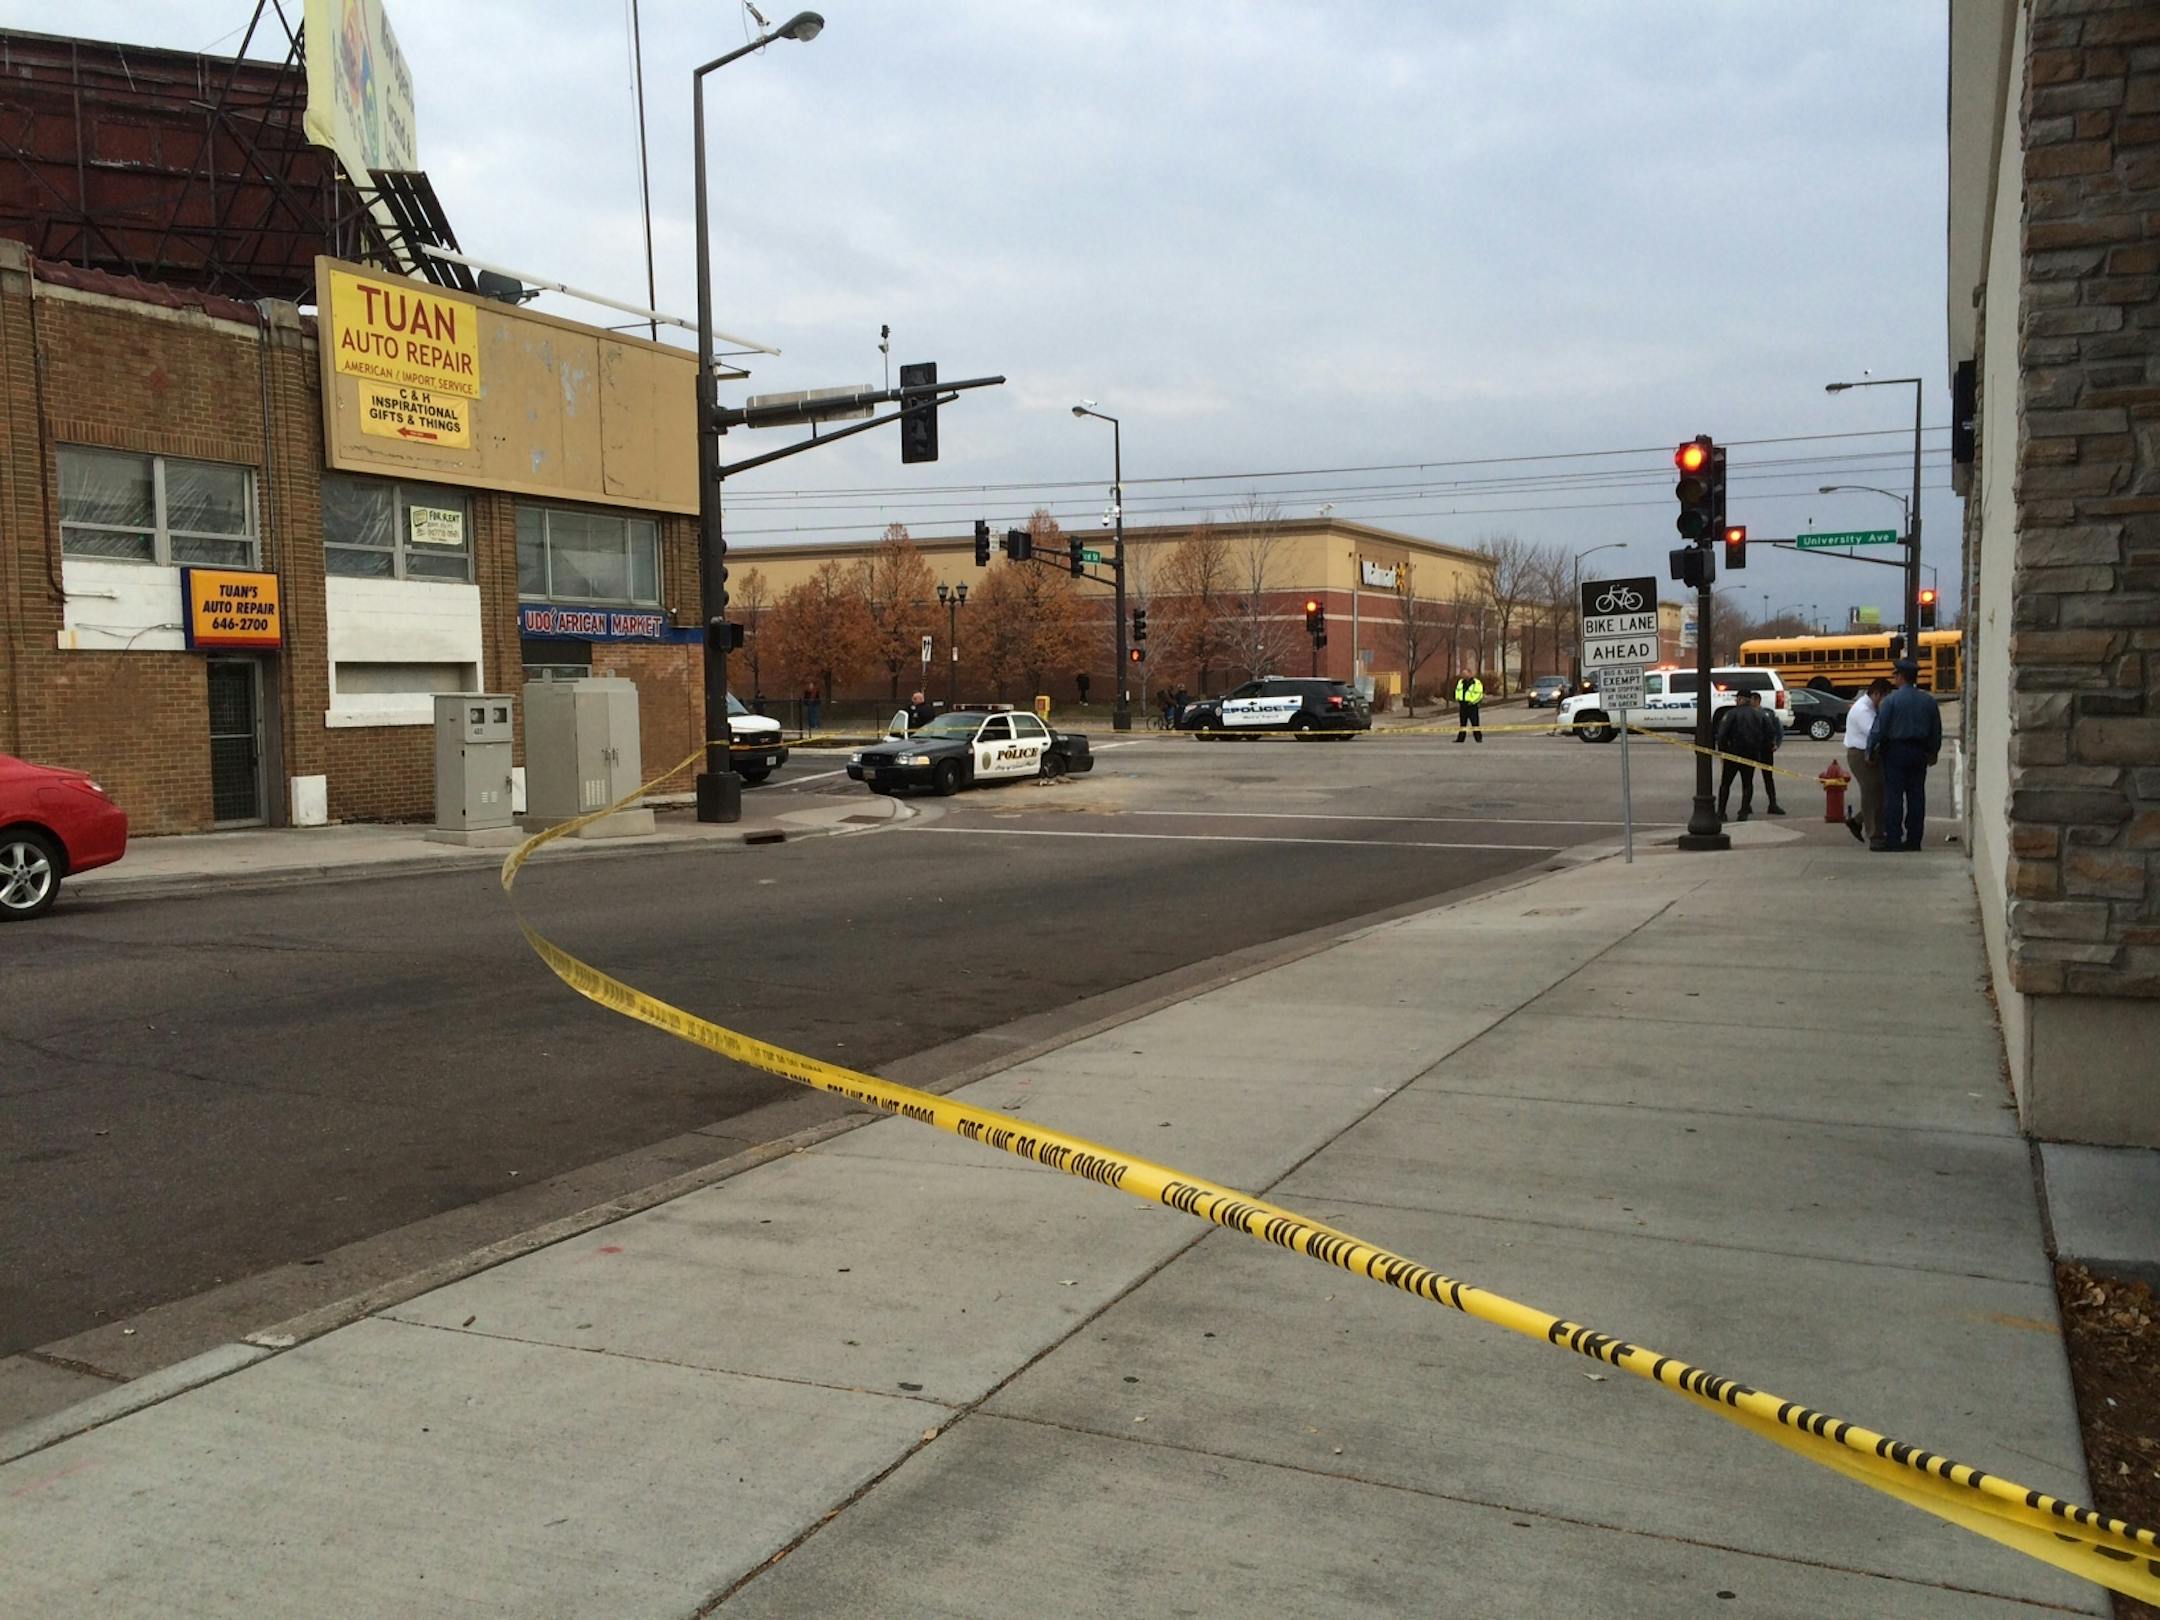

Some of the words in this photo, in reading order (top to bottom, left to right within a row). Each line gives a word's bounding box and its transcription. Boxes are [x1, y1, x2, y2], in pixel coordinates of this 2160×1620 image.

[357, 284, 456, 345] TUAN
[341, 327, 399, 360] AUTO
[406, 340, 473, 376] REPAIR
[344, 360, 393, 378] AMERICAN
[402, 371, 435, 387] IMPORT
[438, 378, 473, 395] SERVICE
[399, 388, 407, 399] C
[411, 390, 419, 401] &
[422, 392, 431, 404] H
[371, 395, 458, 420] INSPIRATIONAL
[369, 408, 404, 423] GIFTS
[407, 414, 415, 425] &
[419, 416, 461, 433] THINGS
[1803, 534, 1862, 546] University
[1868, 533, 1889, 543] Ave
[219, 584, 258, 599] TUAN'S
[202, 600, 233, 614] AUTO
[236, 602, 275, 615] REPAIR
[212, 617, 268, 631] 646-2700
[557, 611, 607, 635] AFRICAN
[611, 613, 663, 638] MARKET
[1586, 618, 1615, 634] BIKE
[1619, 615, 1655, 632] LANE
[1593, 643, 1650, 660] AHEAD
[1603, 675, 1641, 687] EXEMPT
[996, 748, 1039, 761] POLICE
